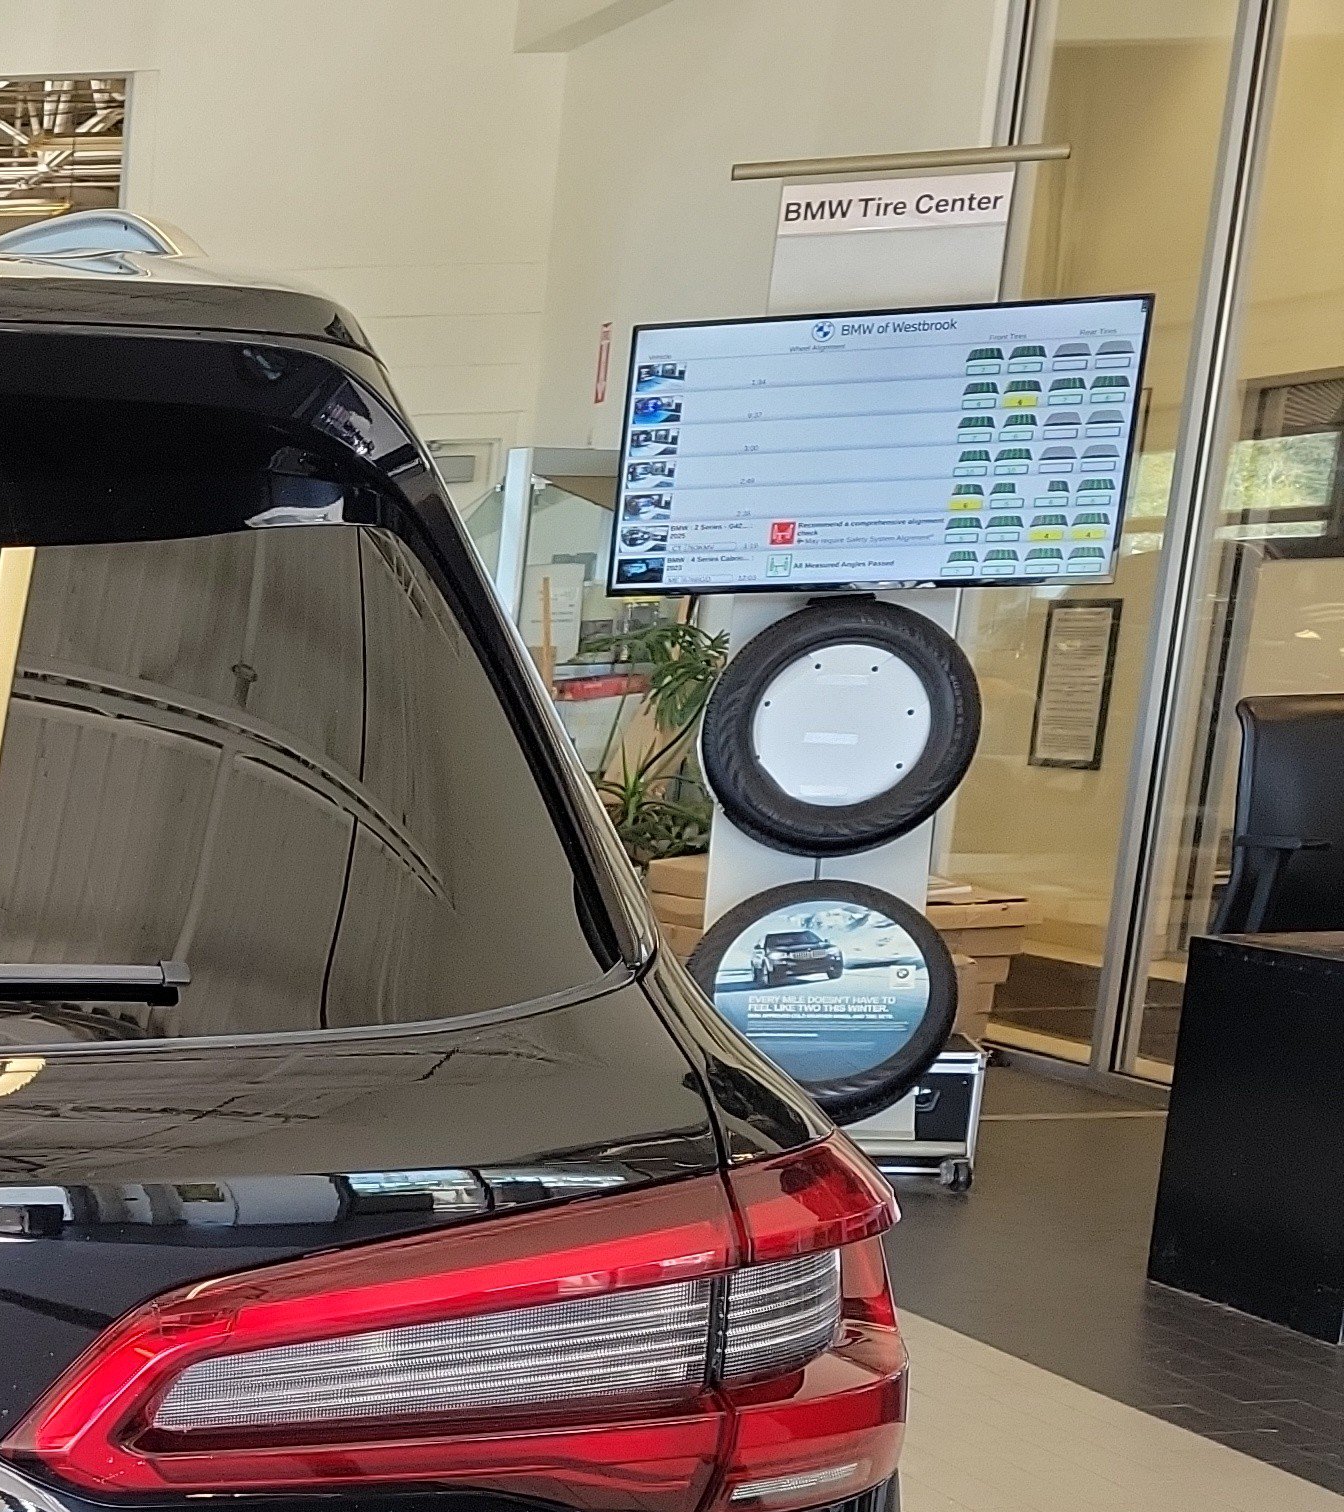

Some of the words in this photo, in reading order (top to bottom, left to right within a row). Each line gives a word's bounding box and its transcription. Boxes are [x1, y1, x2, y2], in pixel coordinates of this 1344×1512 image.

[784, 199, 853, 221] BMW
[859, 197, 907, 217] Tire
[916, 193, 1003, 214] Center
[841, 323, 874, 335] BMW
[877, 322, 890, 333] of
[893, 318, 957, 333] Westbrook
[850, 519, 906, 527] comprehensive
[841, 561, 866, 569] Angles
[808, 996, 850, 1004] DOESN'T
[853, 996, 879, 1004] HAVE
